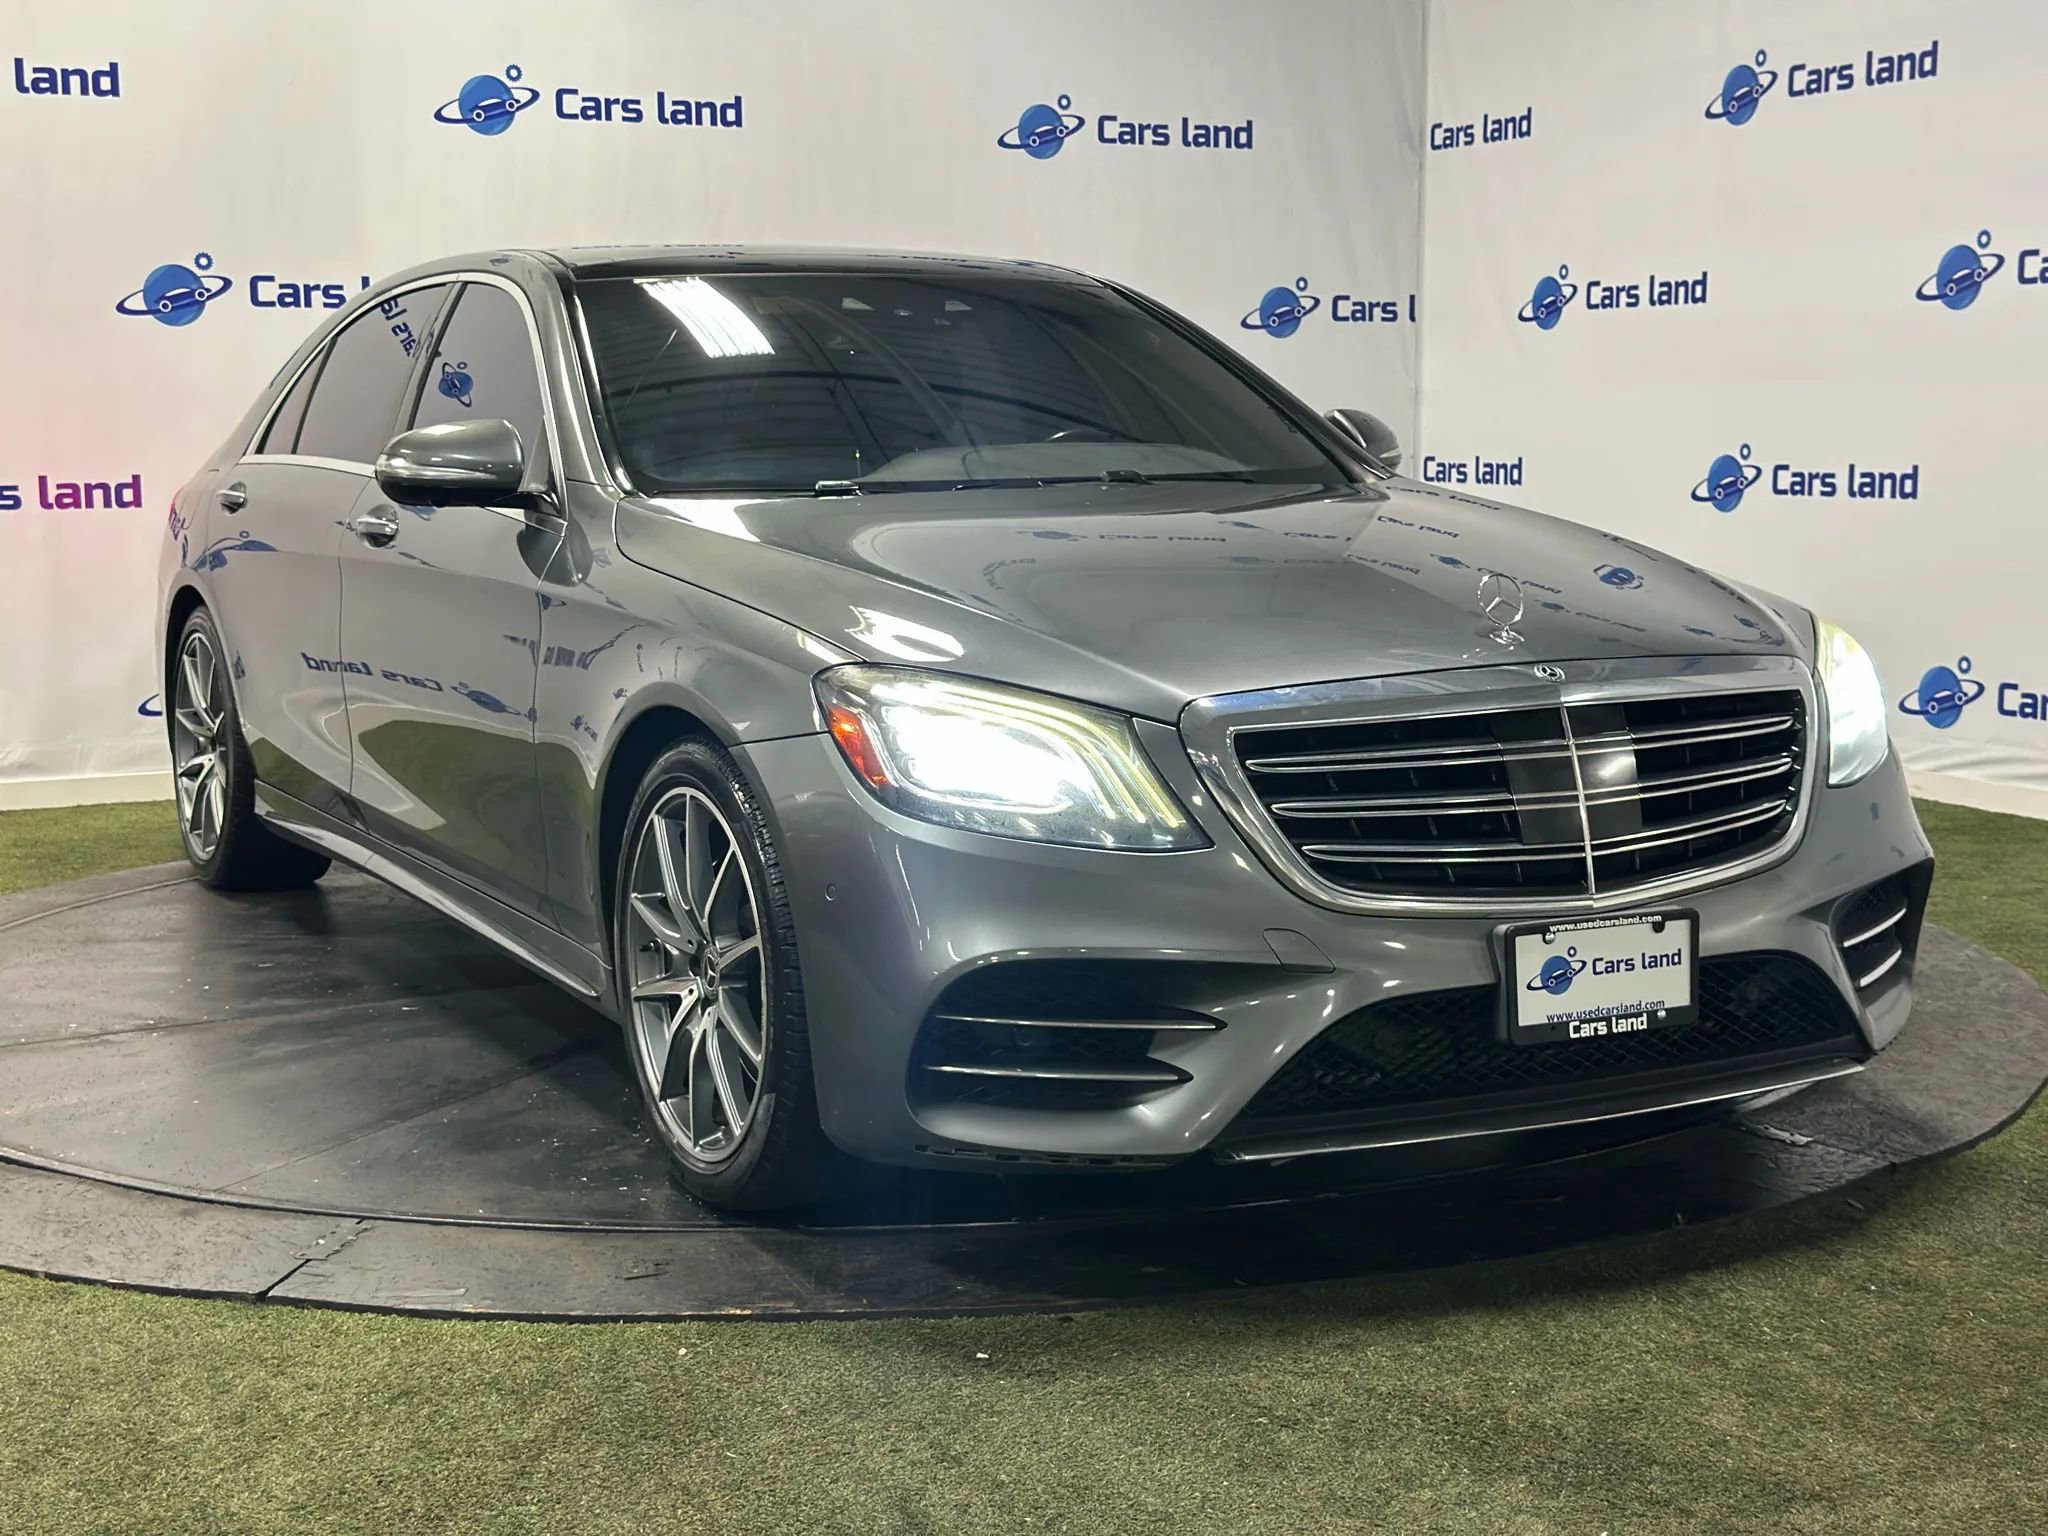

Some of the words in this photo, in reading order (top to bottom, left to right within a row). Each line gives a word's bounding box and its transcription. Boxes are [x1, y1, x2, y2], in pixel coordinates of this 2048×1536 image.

[14, 56, 120, 97] land
[1787, 63, 1855, 98] Cars
[1864, 40, 1939, 87] land
[554, 88, 644, 124] Cars
[656, 91, 743, 129] land
[1097, 114, 1171, 147] Cars
[1181, 117, 1254, 150] land
[1429, 122, 1475, 152] Cars
[1482, 107, 1533, 144] land
[249, 274, 346, 310] Cars
[1331, 294, 1399, 323] Cars
[1585, 279, 1641, 311] Cars
[1648, 271, 1708, 307] land
[1423, 455, 1468, 485] Cars
[1474, 456, 1523, 487] land
[1771, 463, 1838, 498] Cars
[1847, 464, 1920, 501] land
[37, 474, 143, 510] land
[1549, 915, 1662, 933] www.usedcarsland.com
[1592, 957, 1635, 976] Cars
[1641, 948, 1682, 970] land
[1546, 999, 1665, 1023] www.usedcarsland.com
[1568, 1020, 1608, 1039] Cars
[1612, 1013, 1648, 1034] land
